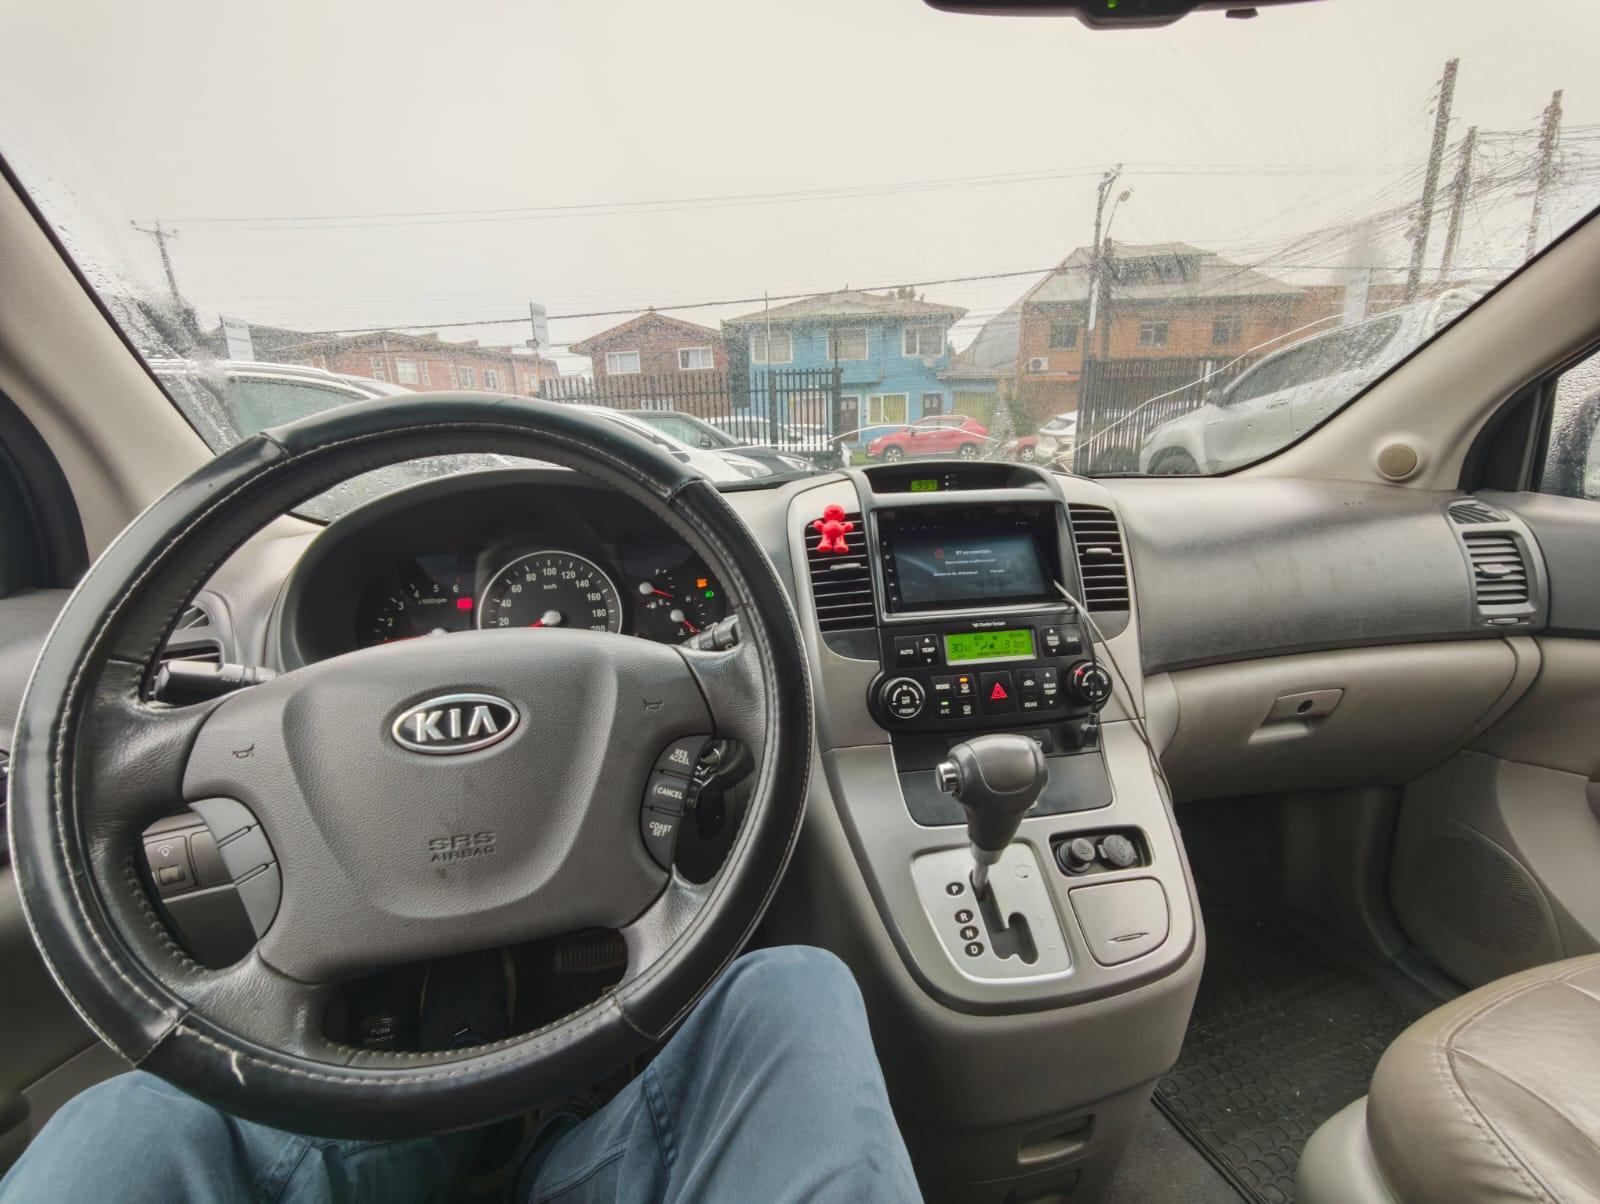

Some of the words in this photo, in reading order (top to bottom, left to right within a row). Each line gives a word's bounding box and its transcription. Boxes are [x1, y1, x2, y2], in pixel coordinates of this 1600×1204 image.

[543, 567, 557, 576] 100
[561, 571, 576, 579] 120
[526, 573, 537, 582] 80
[433, 584, 440, 592] 5
[575, 579, 590, 588] 140
[452, 584, 459, 593] 6
[511, 585, 522, 593] 60
[413, 590, 419, 598] 4
[587, 593, 601, 601] 160
[398, 602, 405, 610] 3
[501, 598, 512, 607] 40
[592, 609, 606, 617] 180
[387, 618, 393, 627] 2
[499, 617, 510, 626] 20
[414, 705, 499, 743] KIA
[674, 748, 689, 757] RES
[668, 753, 690, 766] ACCEL
[657, 787, 682, 799] CANCEL
[649, 820, 673, 833] COAST
[651, 827, 667, 838] SET
[428, 831, 497, 852] SRS
[952, 886, 959, 894] P
[960, 913, 968, 921] R
[966, 930, 973, 938] N
[971, 946, 978, 954] D
